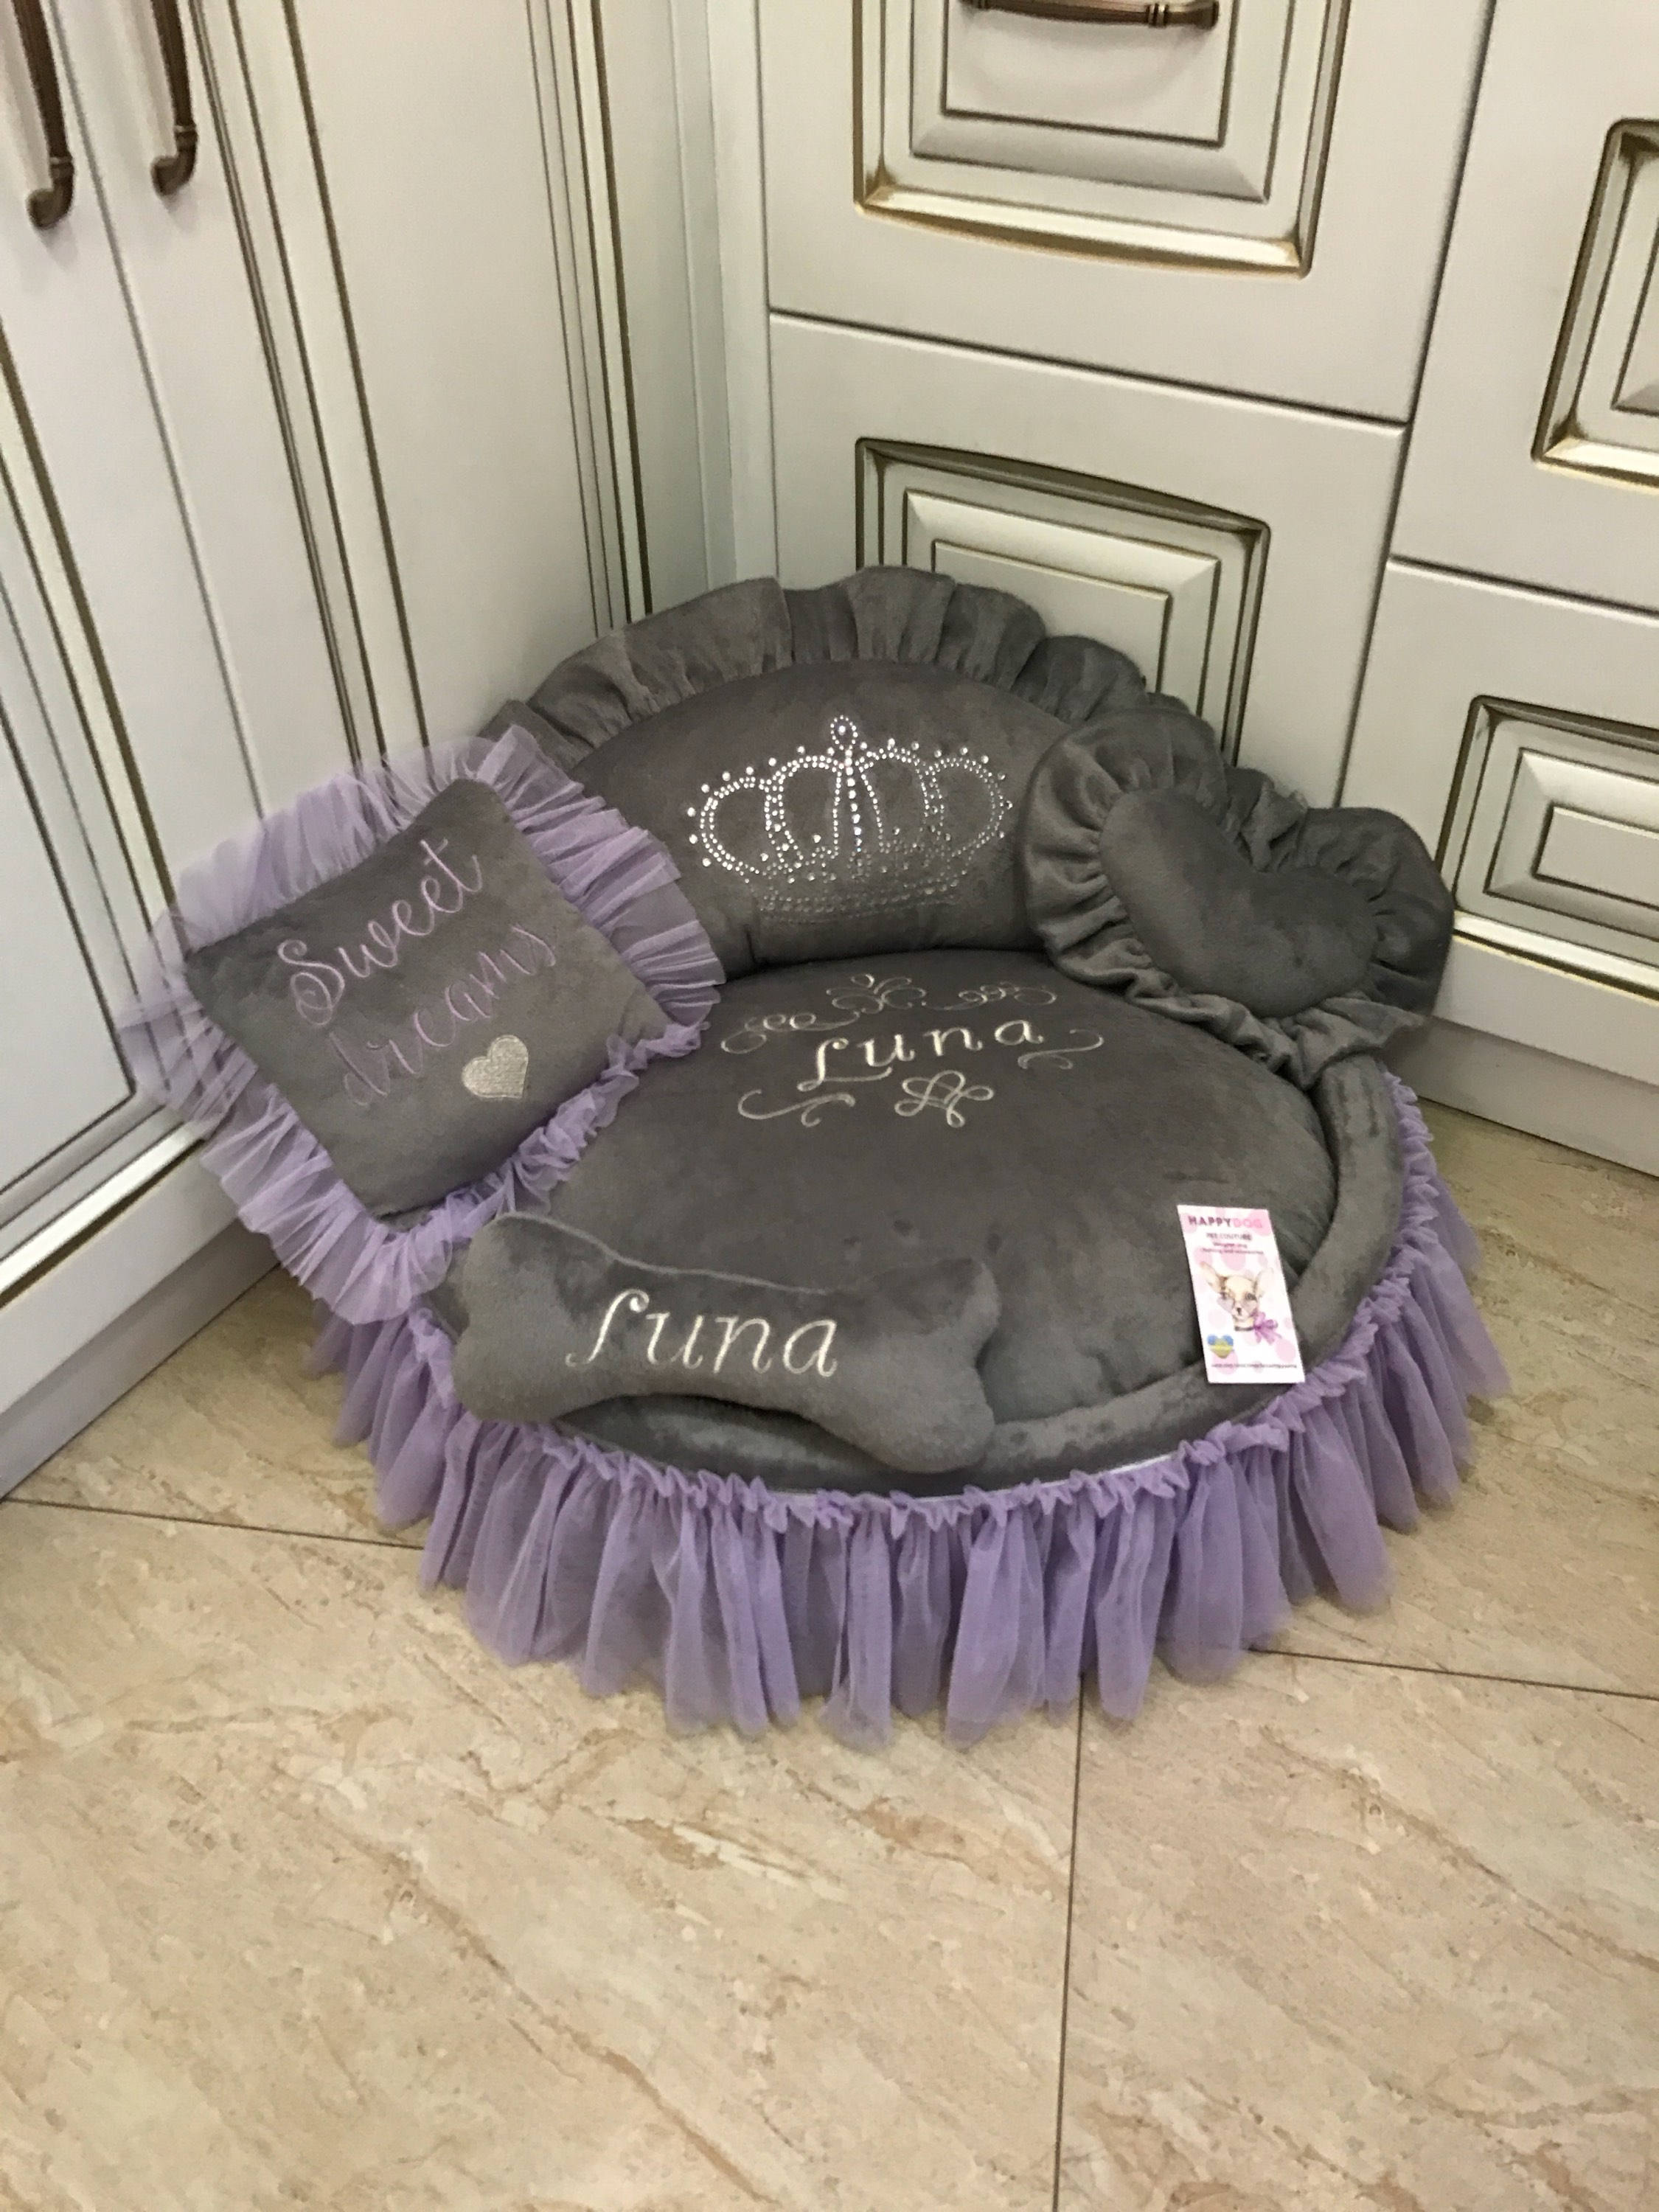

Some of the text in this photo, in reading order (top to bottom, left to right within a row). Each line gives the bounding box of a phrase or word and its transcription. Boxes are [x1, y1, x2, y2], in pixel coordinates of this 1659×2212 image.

[277, 838, 484, 1027] Sweet
[796, 1019, 1044, 1092] Luna
[564, 1287, 838, 1378] Luna
